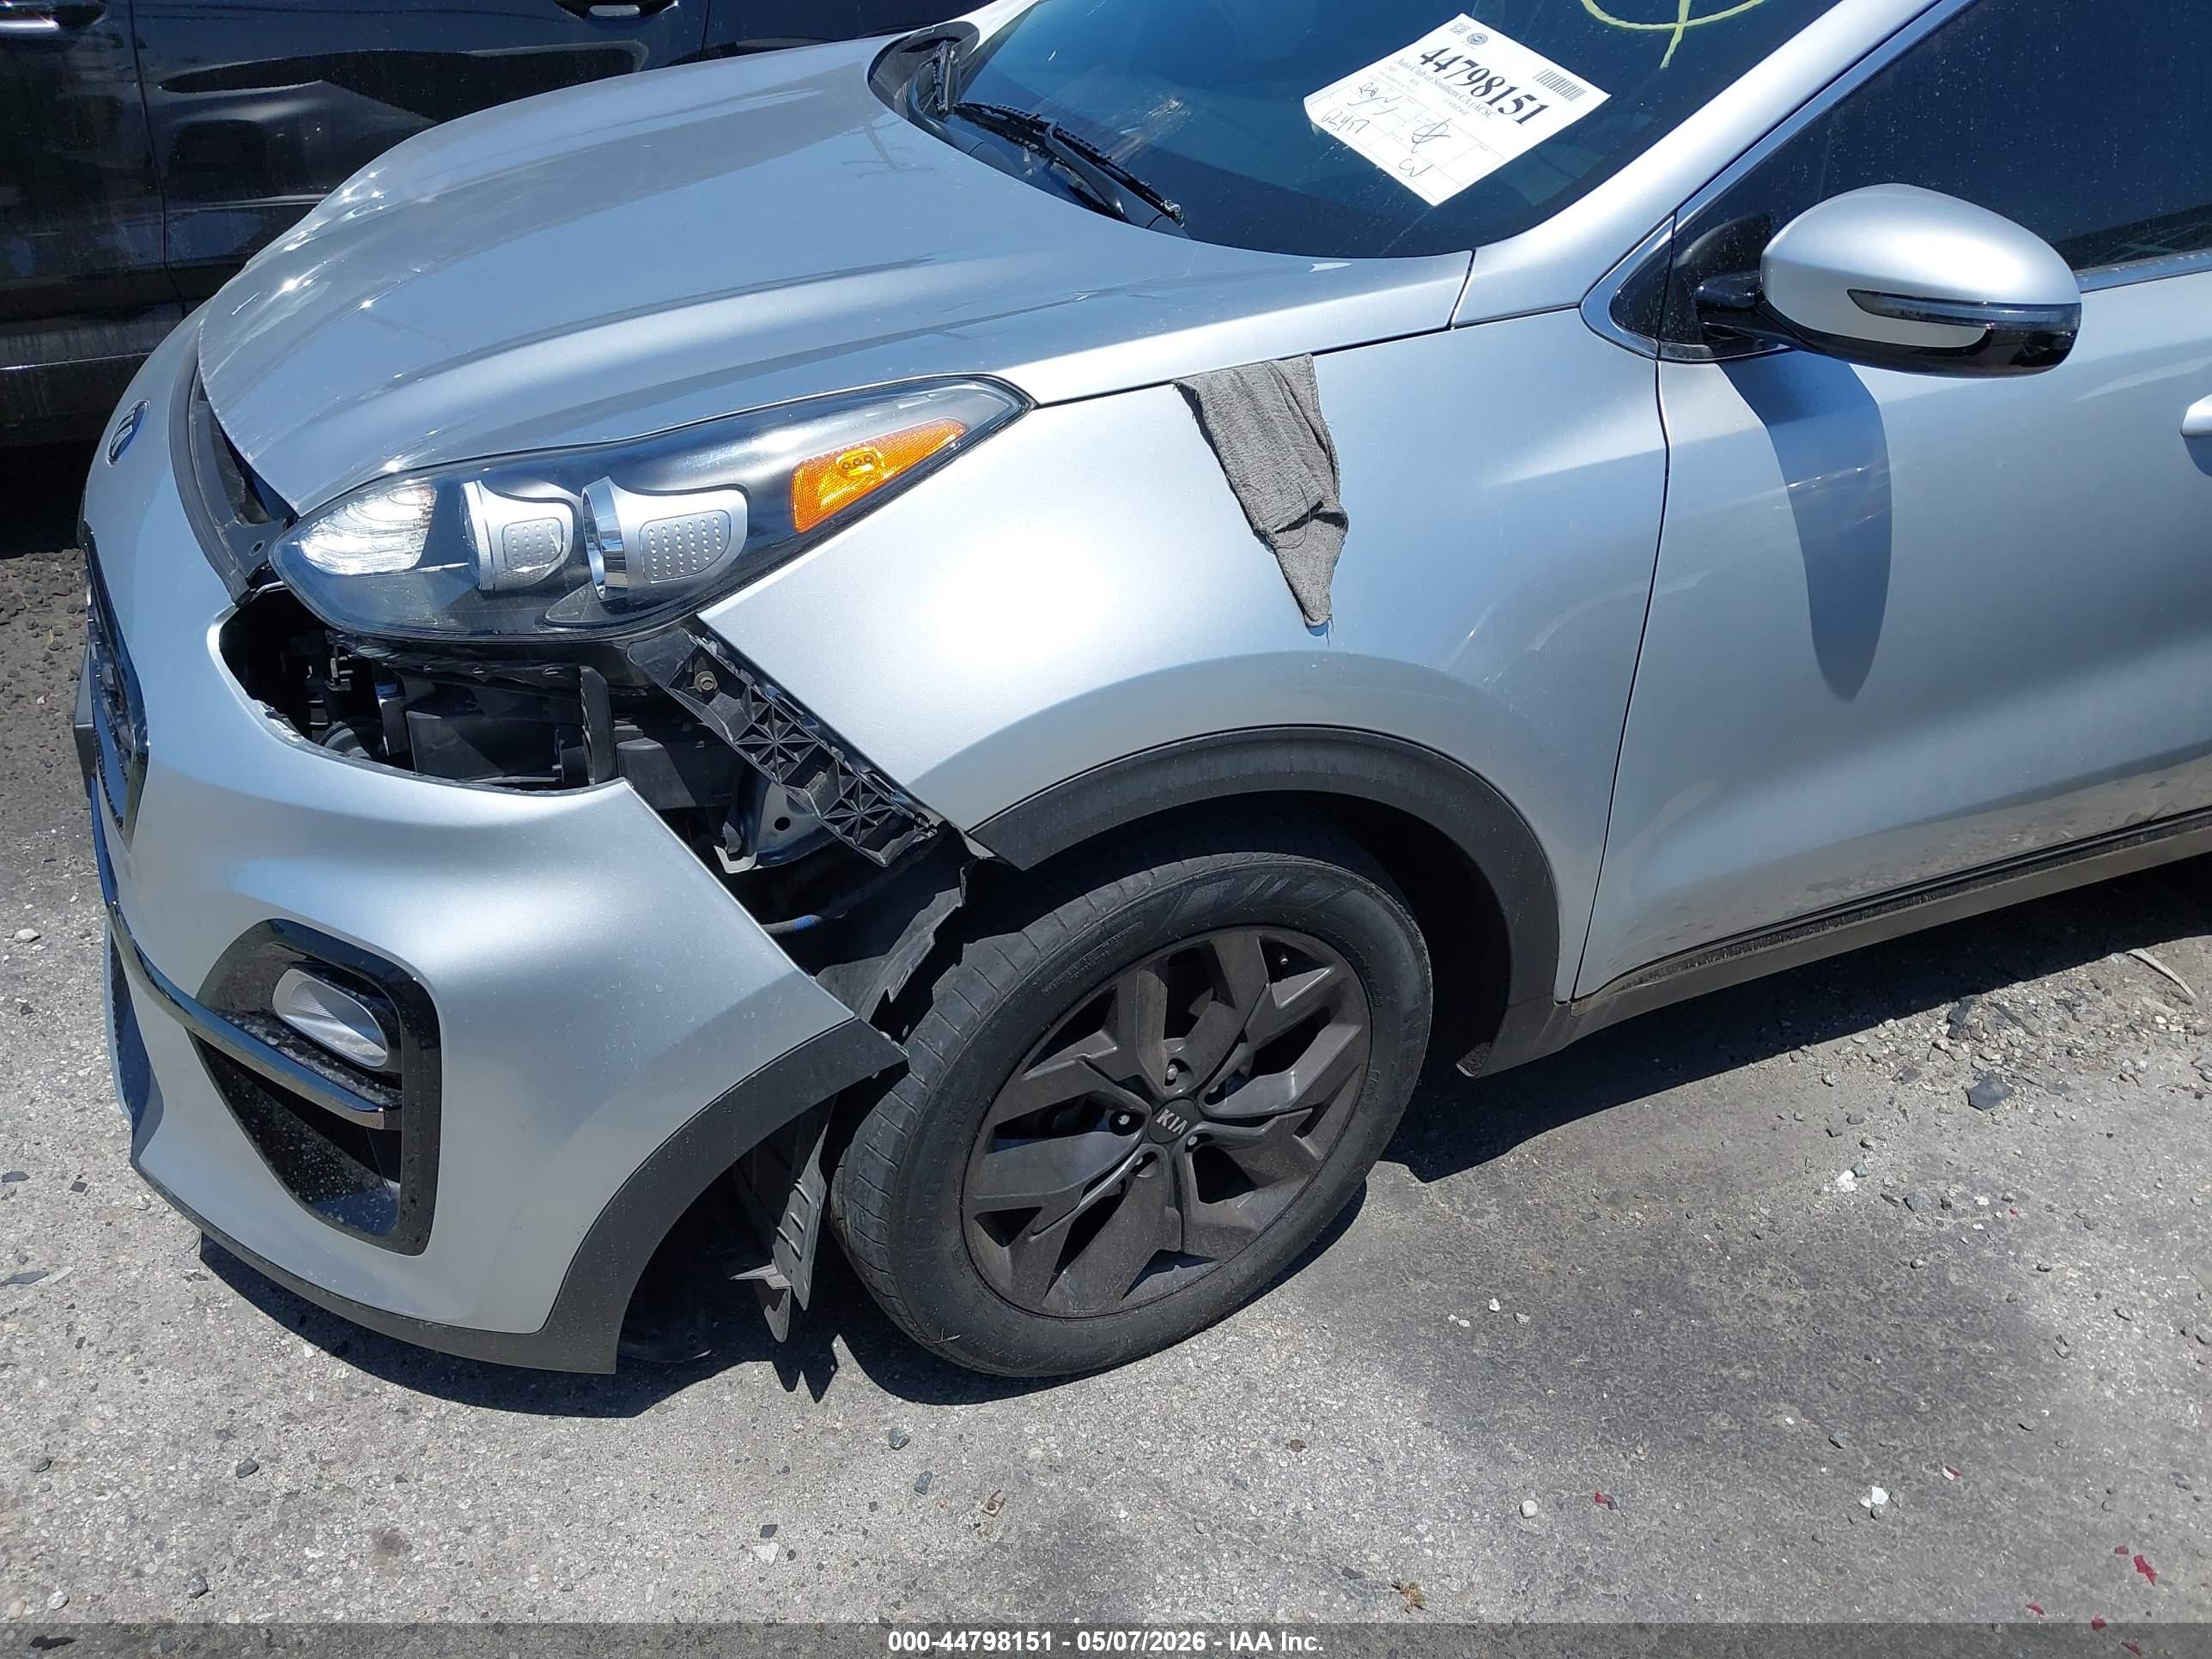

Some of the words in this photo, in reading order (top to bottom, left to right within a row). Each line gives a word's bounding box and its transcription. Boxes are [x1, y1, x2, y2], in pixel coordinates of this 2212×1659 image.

[1410, 66, 1426, 76] Club
[1431, 77, 1462, 98] Southern
[1419, 47, 1549, 125] 44798151
[1156, 1108, 1188, 1135] KIA
